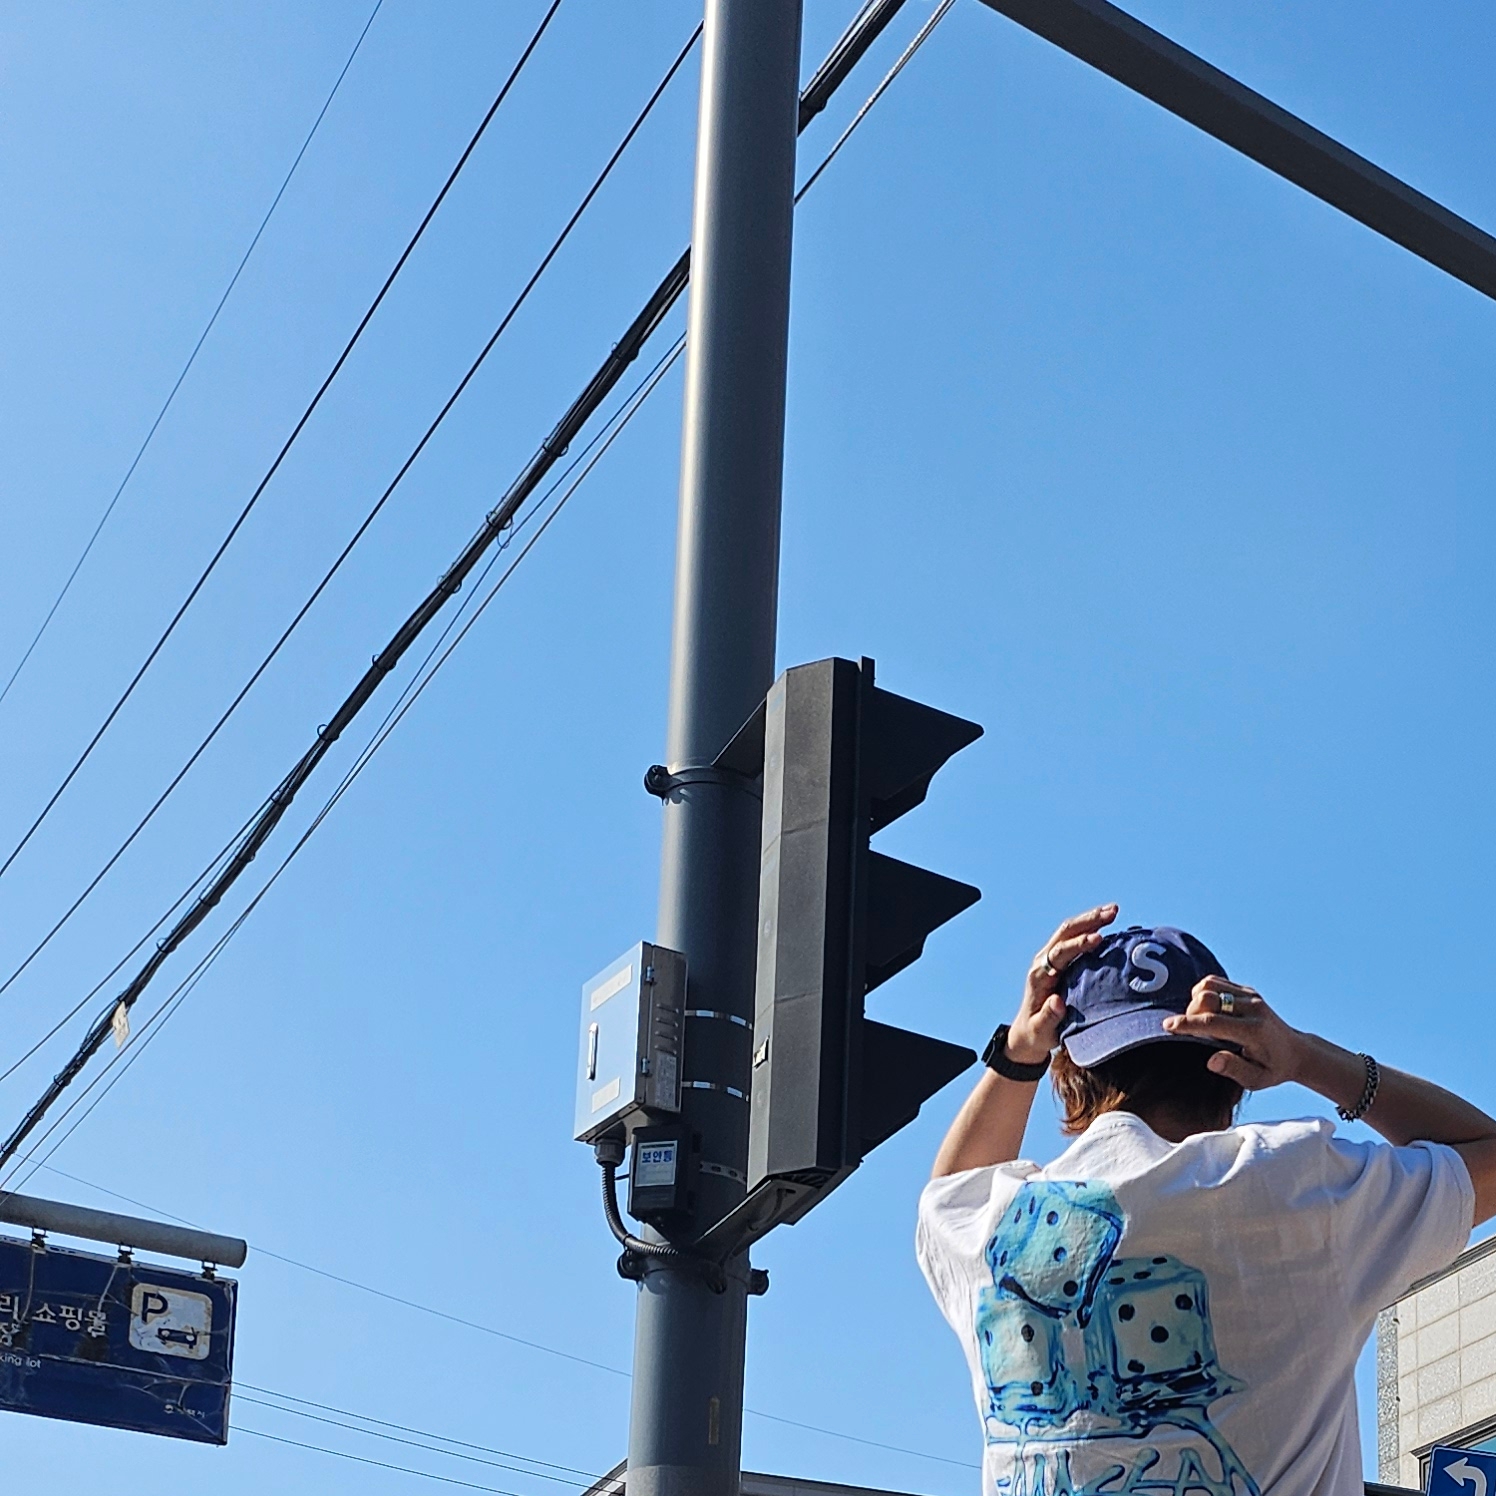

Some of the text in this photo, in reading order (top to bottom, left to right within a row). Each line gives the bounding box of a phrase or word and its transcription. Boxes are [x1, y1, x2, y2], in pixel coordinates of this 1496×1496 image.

[1129, 942, 1168, 993] S
[642, 1151, 672, 1163] 보안등
[32, 1303, 107, 1338] 쇼핑몰
